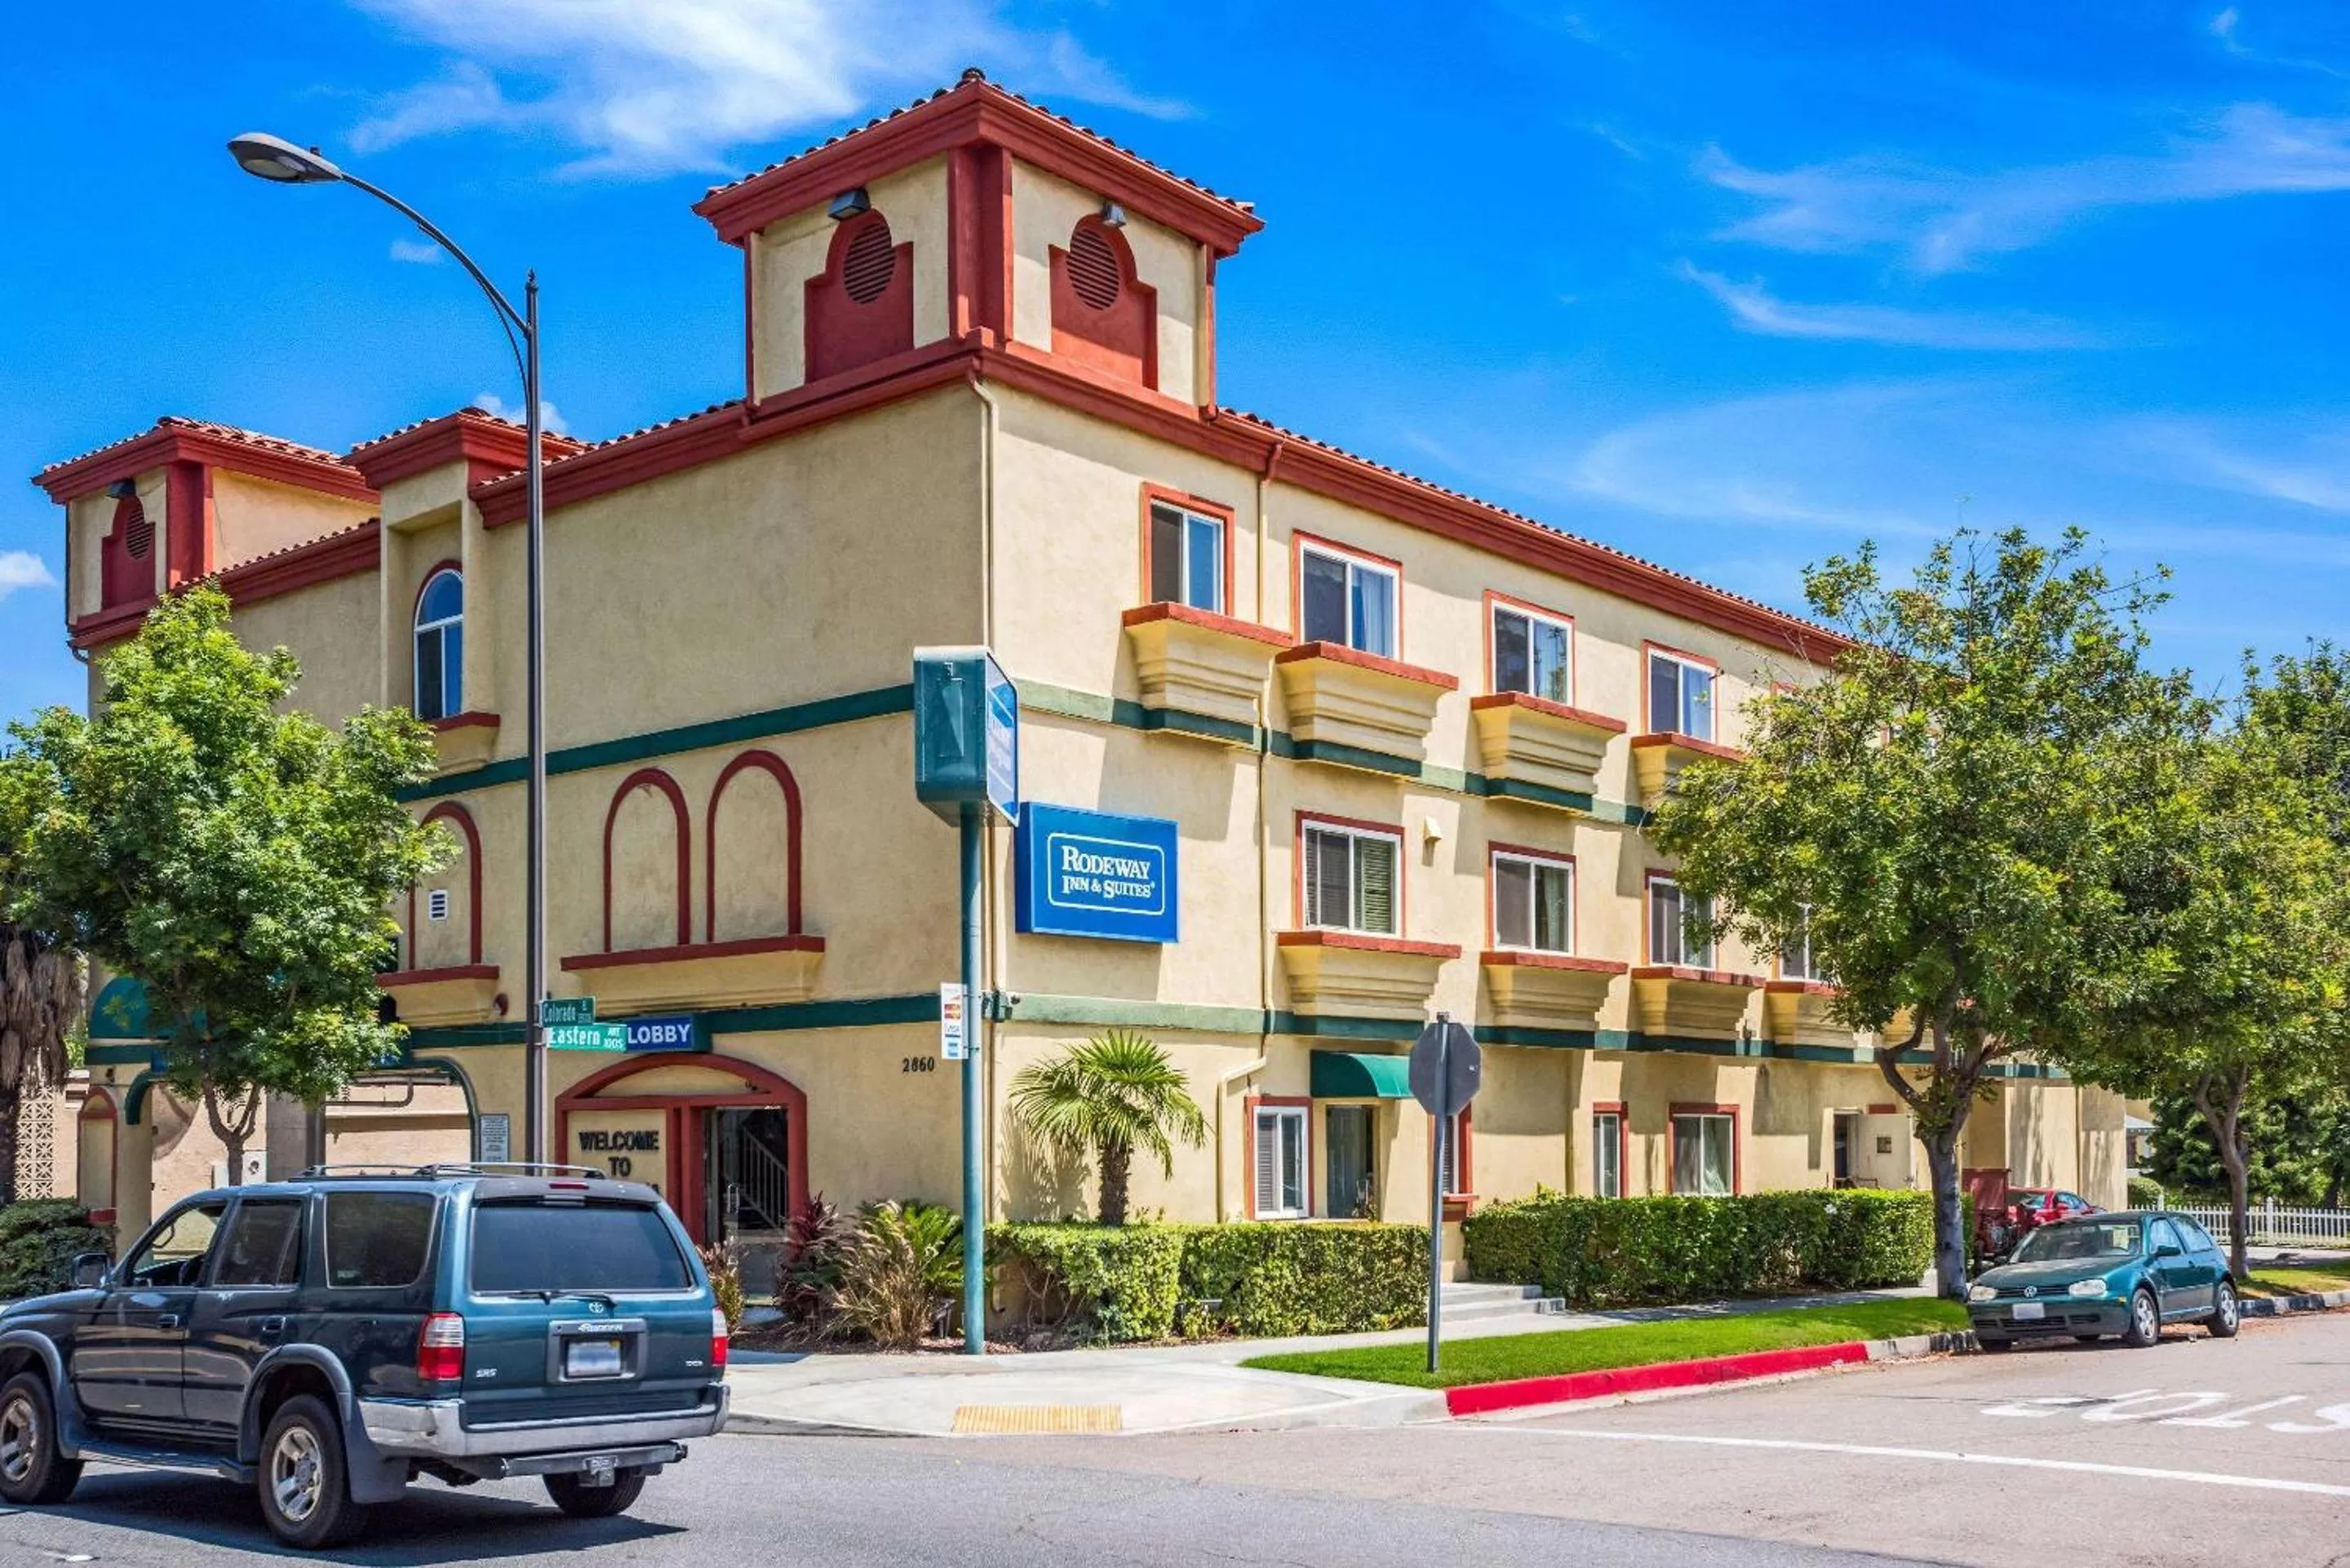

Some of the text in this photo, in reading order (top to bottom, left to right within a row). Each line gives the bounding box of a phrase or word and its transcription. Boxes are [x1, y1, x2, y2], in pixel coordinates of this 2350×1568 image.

[1062, 845, 1151, 879] RODEWAY
[1062, 875, 1151, 898] INN & SUITES
[543, 1003, 576, 1022] Colorado
[549, 1025, 601, 1045] Eastern
[627, 1023, 691, 1044] LOBBY
[579, 1131, 660, 1150] WELCOME
[607, 1156, 632, 1177] TO
